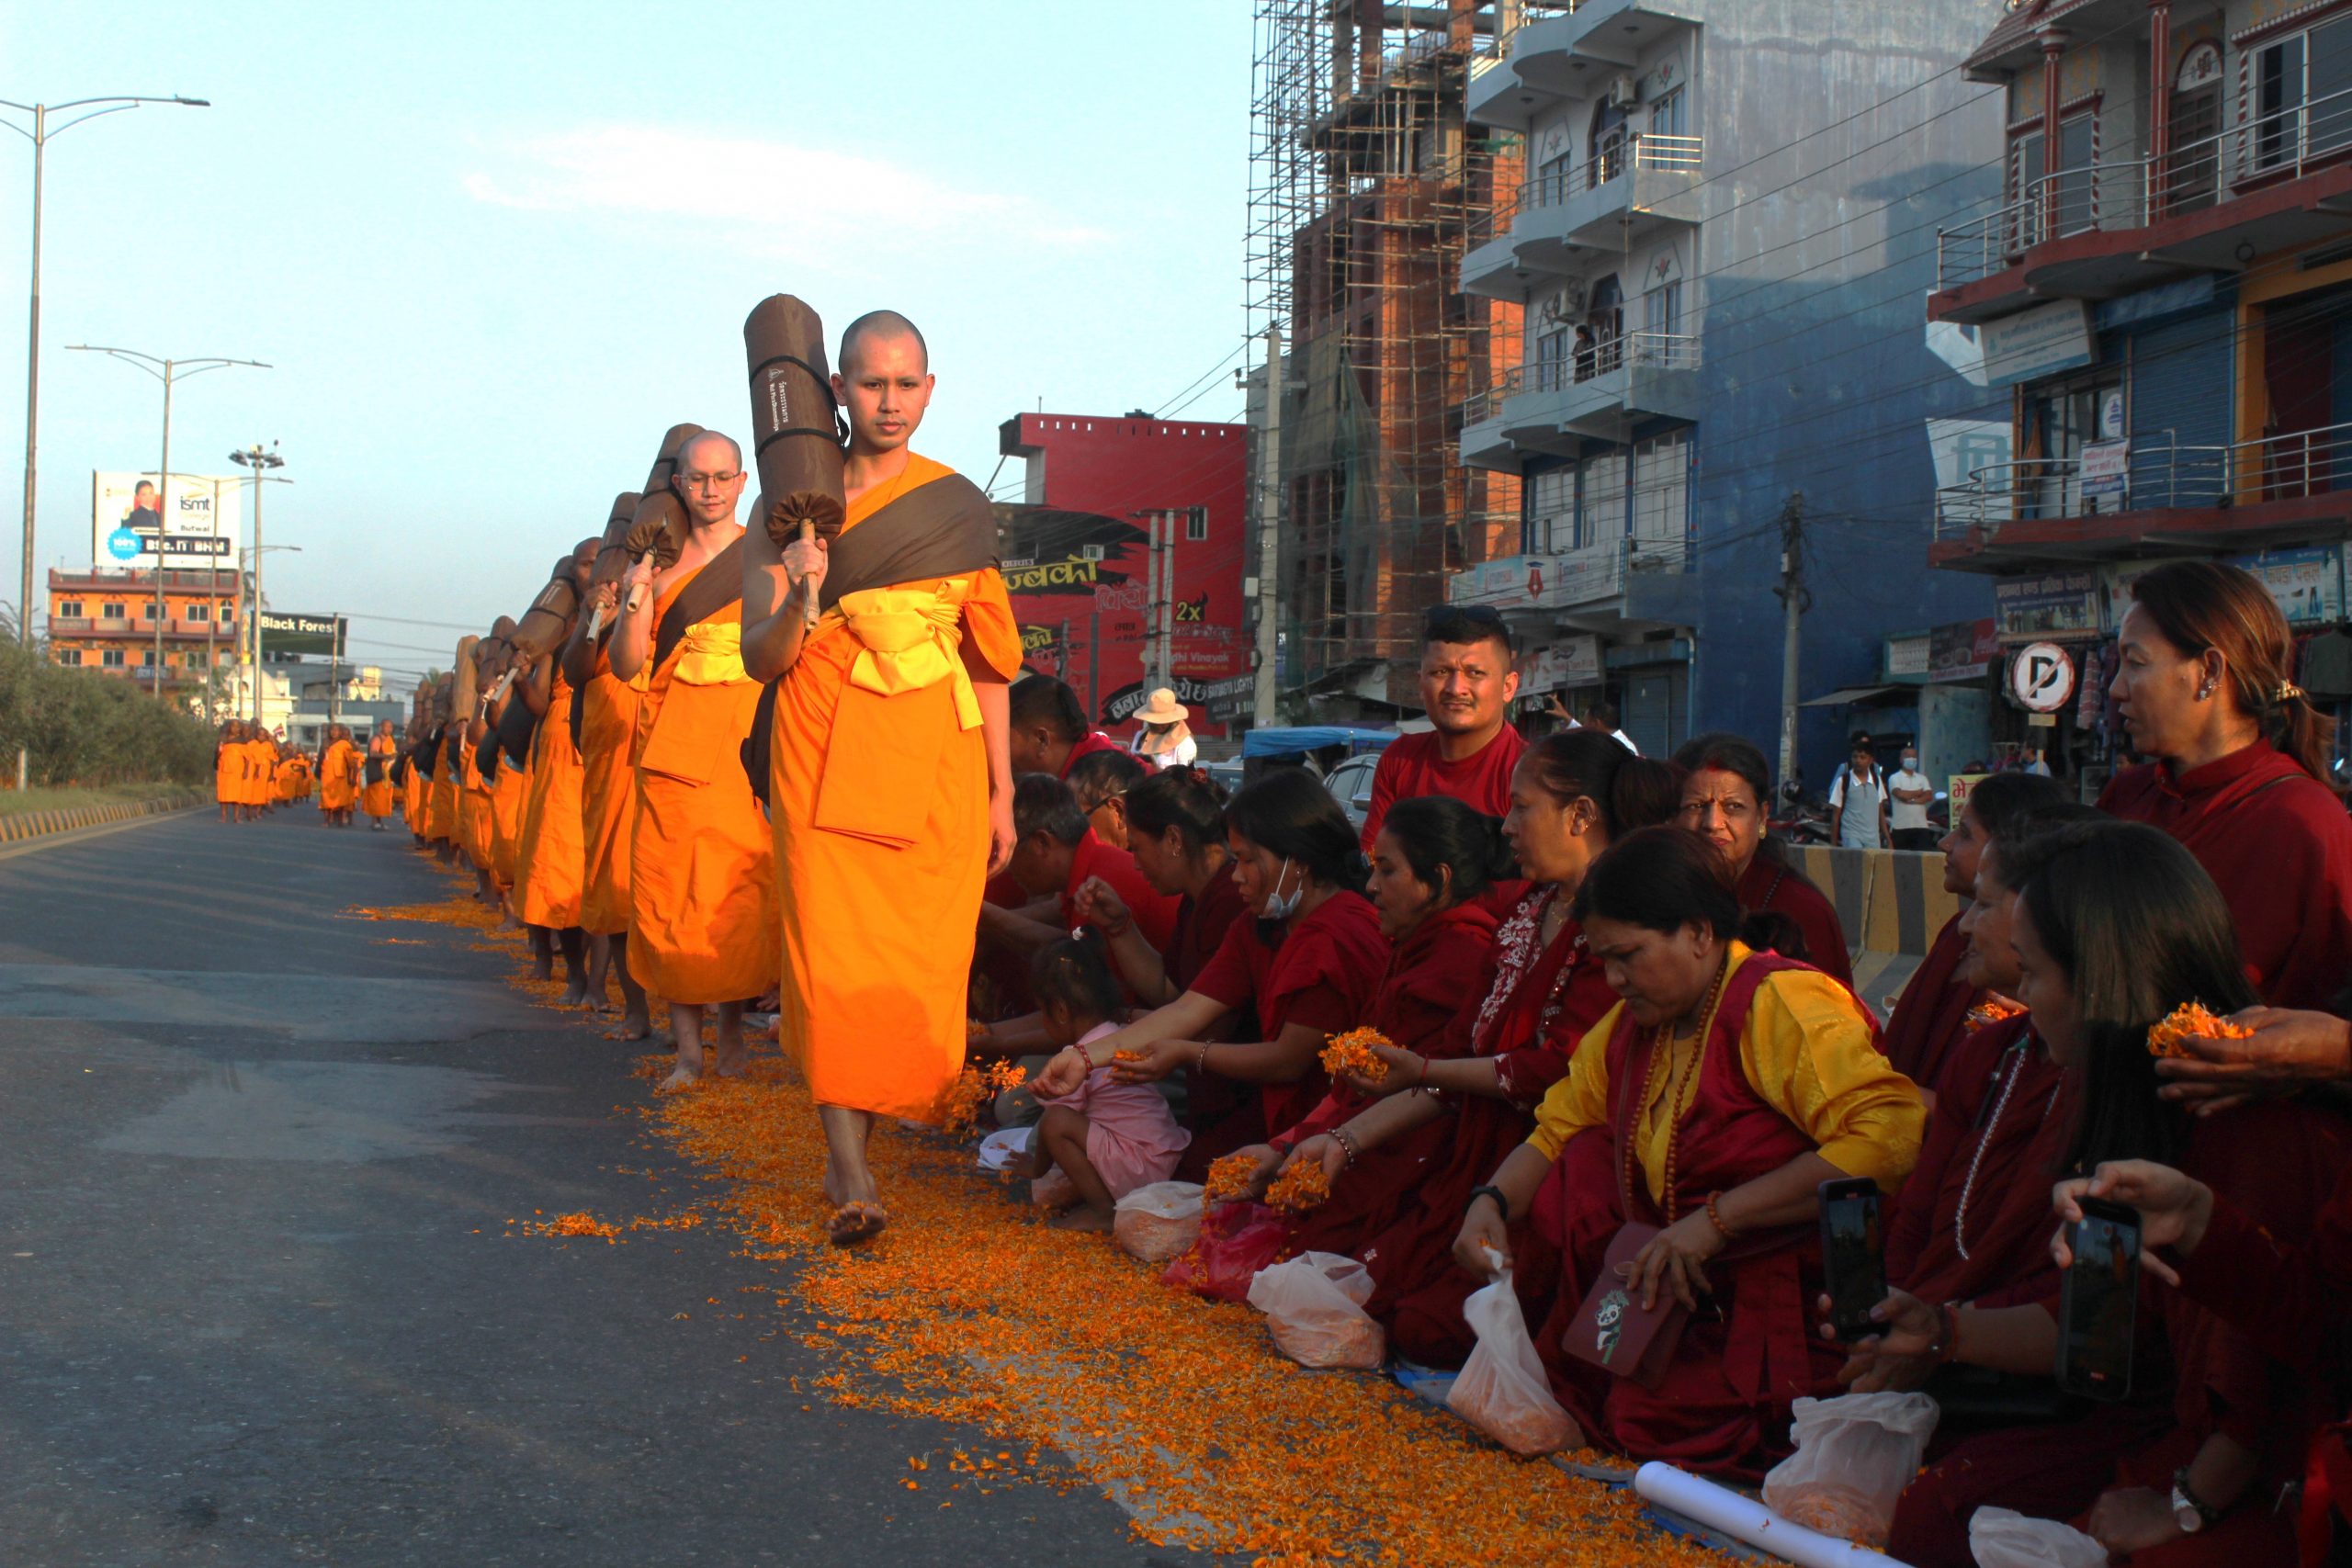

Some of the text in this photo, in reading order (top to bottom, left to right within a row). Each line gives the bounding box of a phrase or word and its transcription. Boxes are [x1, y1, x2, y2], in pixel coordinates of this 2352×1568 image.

[180, 496, 210, 511] ismt
[1176, 602, 1201, 621] 2x
[261, 616, 295, 630] Black
[1191, 651, 1229, 664] Vinayak
[2030, 656, 2058, 699] P
